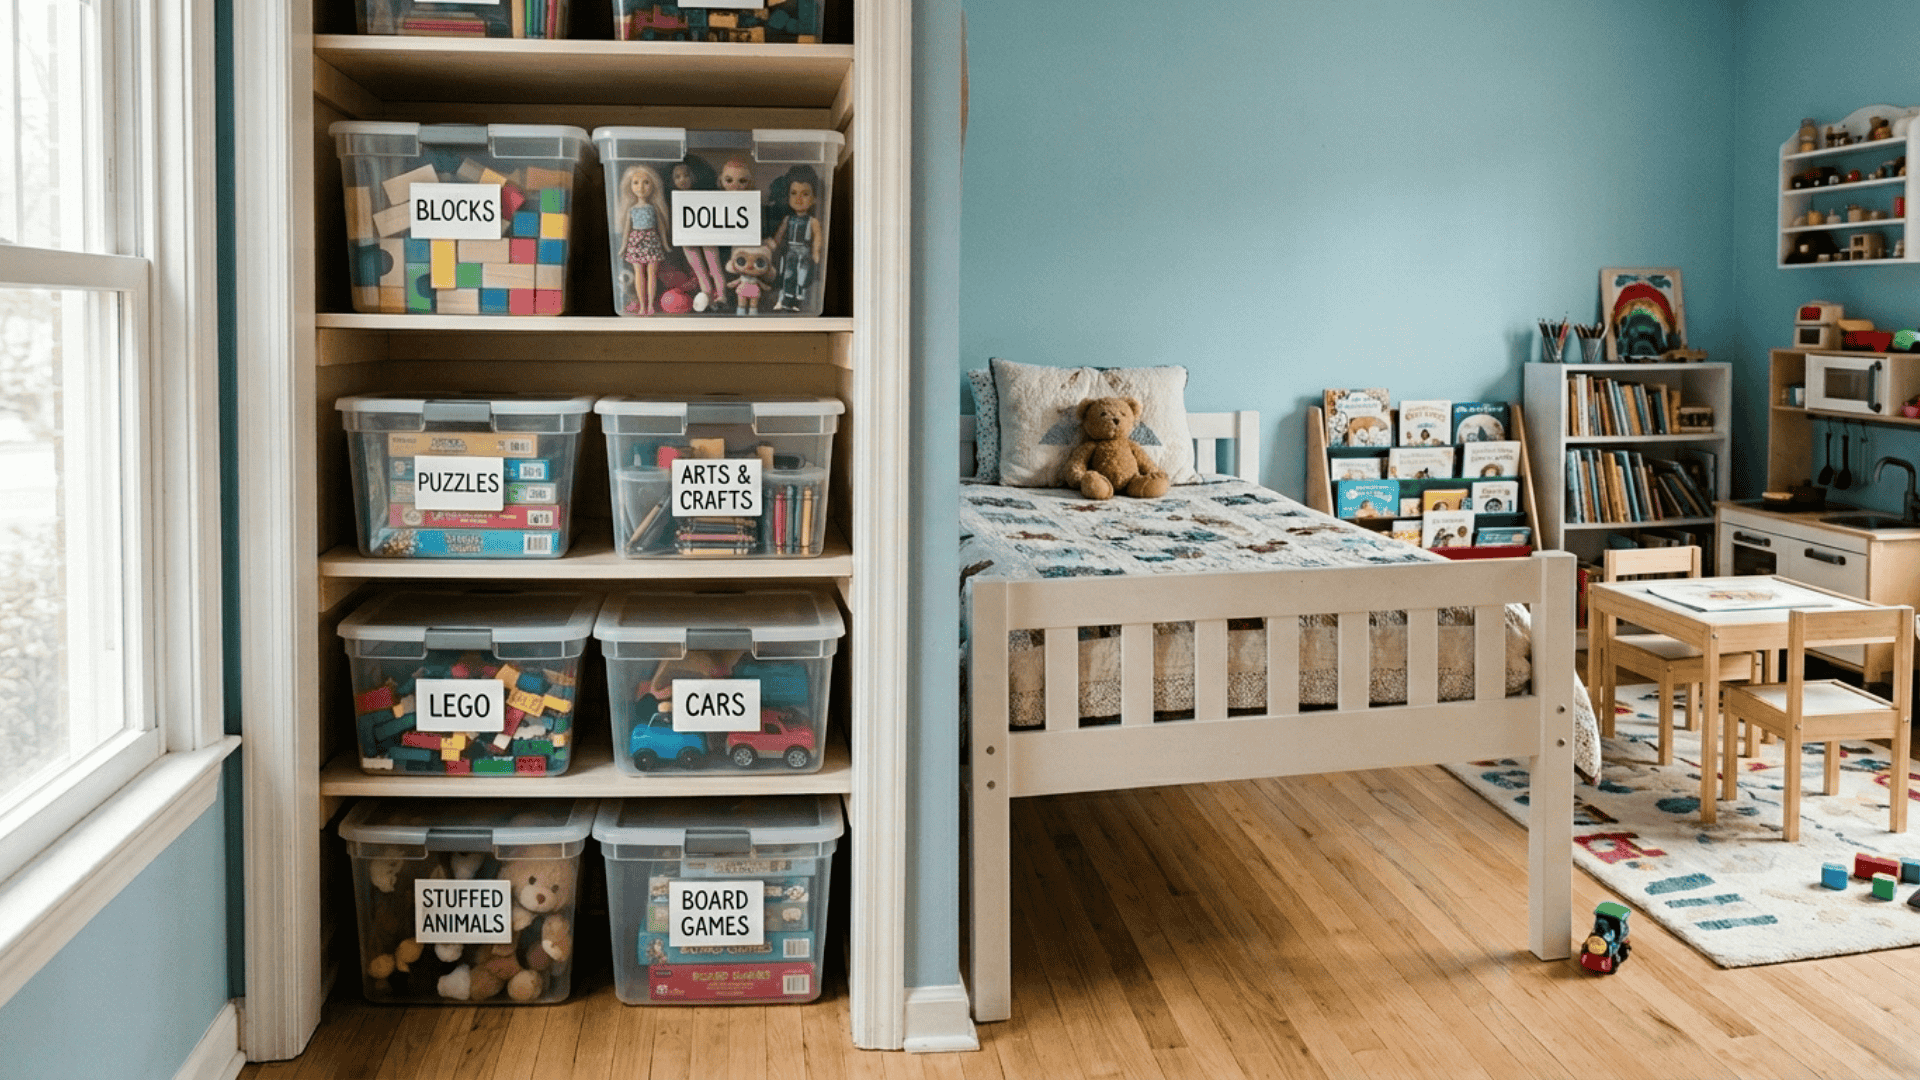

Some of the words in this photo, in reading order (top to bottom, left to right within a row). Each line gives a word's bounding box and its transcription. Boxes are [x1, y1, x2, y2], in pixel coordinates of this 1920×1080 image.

[417, 199, 495, 222] BLOCKS
[683, 206, 749, 229] DOLLS
[419, 472, 499, 493] PUZZLES
[682, 464, 731, 485] ARTS
[737, 464, 751, 485] &
[680, 490, 753, 510] CRAFTS
[429, 693, 491, 718] LEGO
[685, 692, 746, 717] CARS
[422, 888, 504, 909] STUFFED
[682, 889, 749, 911] BOARD
[421, 913, 505, 934] ANIMALS
[681, 915, 750, 937] GAMES
